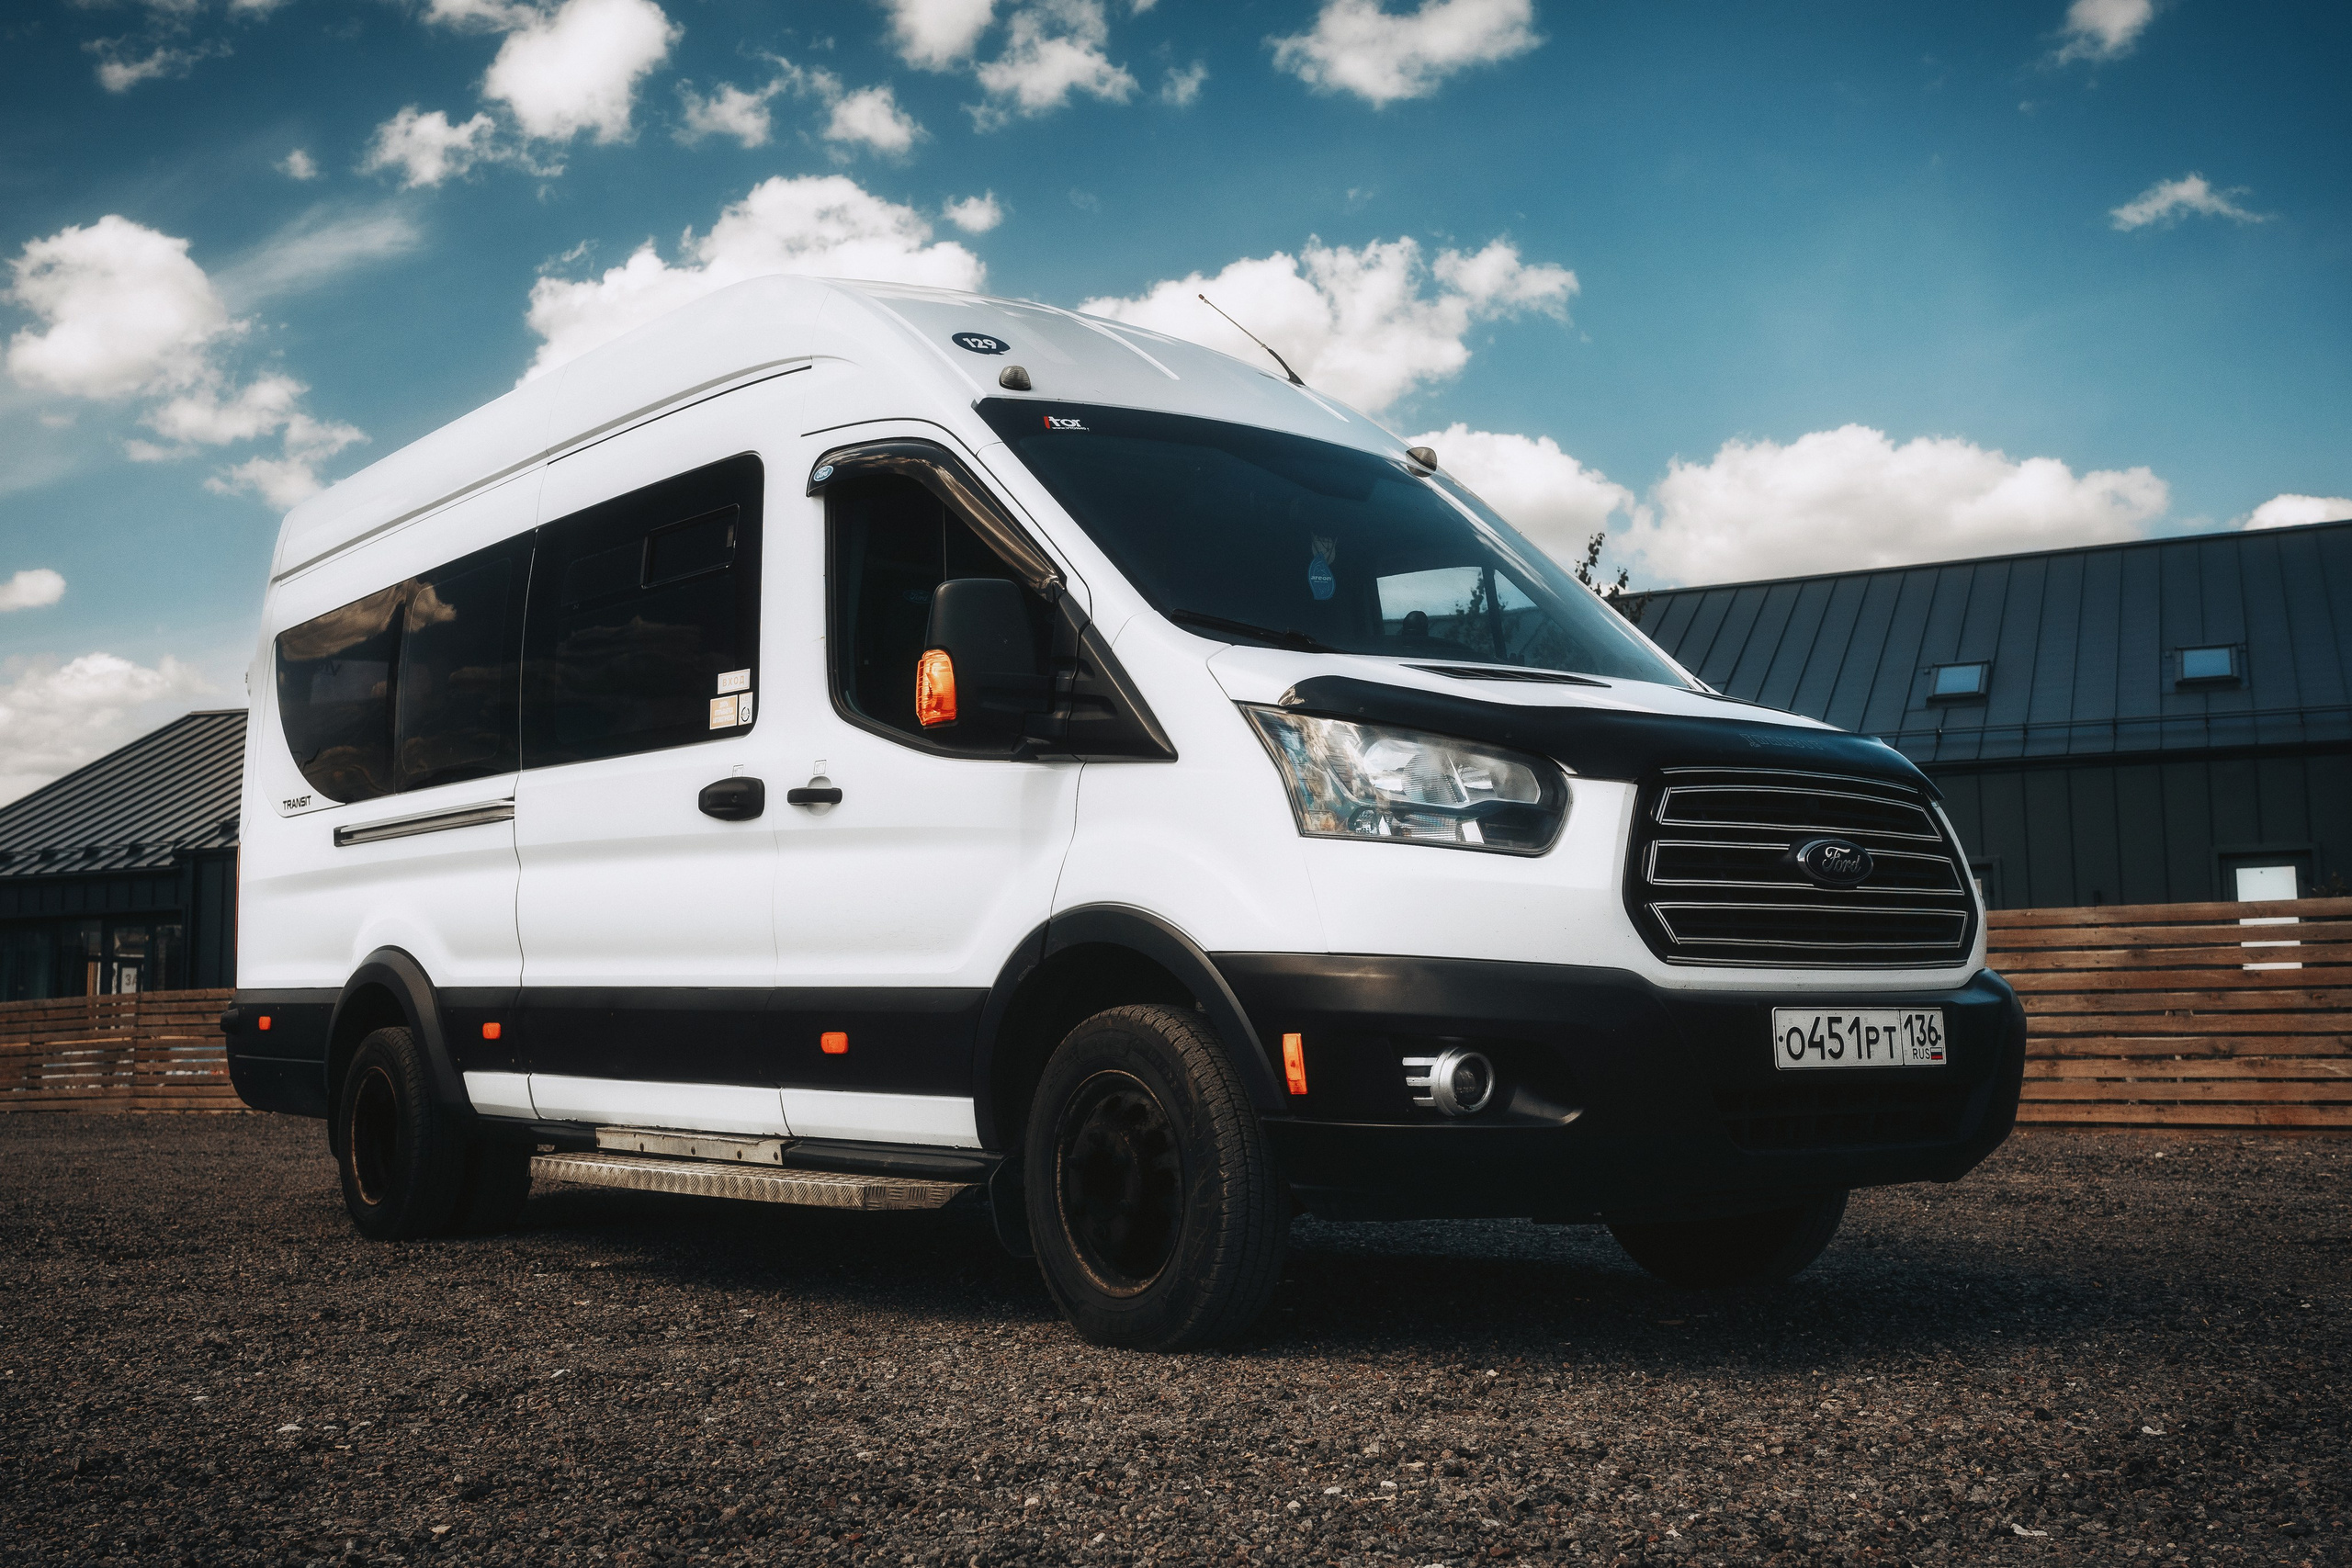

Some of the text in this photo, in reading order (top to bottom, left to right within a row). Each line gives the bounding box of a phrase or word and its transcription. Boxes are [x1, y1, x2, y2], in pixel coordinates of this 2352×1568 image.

[962, 336, 997, 349] 129
[722, 675, 745, 687] ВХОД
[282, 795, 311, 810] TRANSIT
[1822, 846, 1861, 873] Ford
[1904, 1014, 1939, 1046] 136
[1912, 1048, 1930, 1059] RUS
